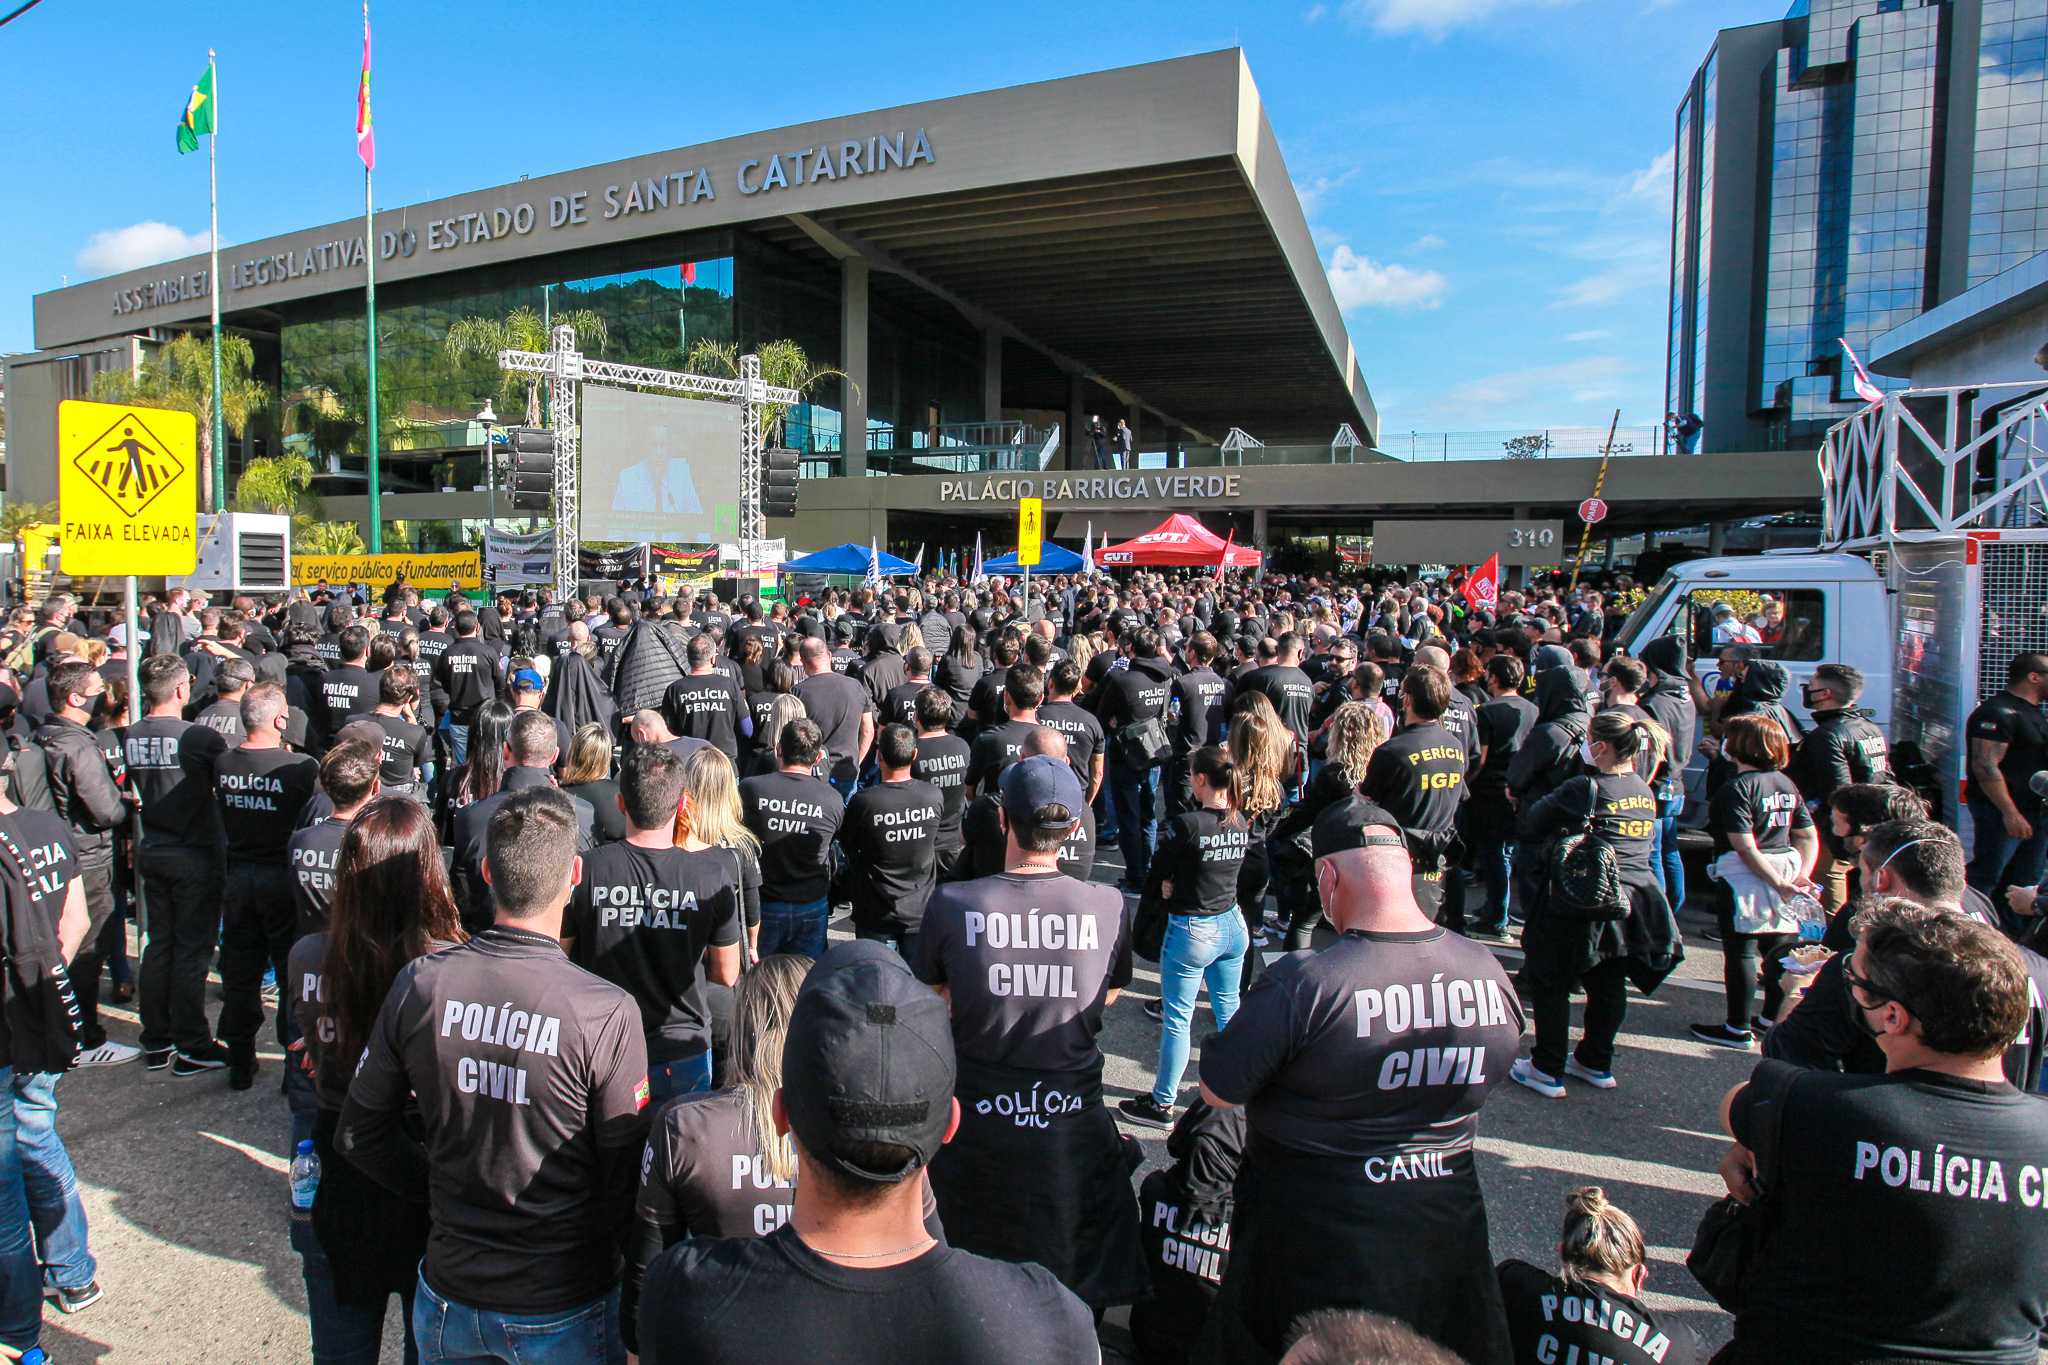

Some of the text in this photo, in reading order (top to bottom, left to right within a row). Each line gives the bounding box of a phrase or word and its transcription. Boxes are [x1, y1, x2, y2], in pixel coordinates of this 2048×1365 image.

[231, 237, 367, 290] LEGISLATIVA
[381, 228, 417, 260] DO
[428, 202, 535, 252] ESTADO
[550, 190, 588, 228] DE
[604, 170, 716, 219] SANTA
[737, 128, 936, 196] CATARINA
[940, 474, 1241, 501] PALÁCIO BARRIGA VERDE
[1587, 501, 1599, 521] PARE
[66, 523, 191, 542] FAIXA ELEVADA
[1138, 533, 1185, 542] CUT
[1508, 528, 1554, 549] 310
[1103, 552, 1127, 562] CUT
[306, 564, 348, 582] serviço
[351, 561, 392, 583] público
[403, 560, 478, 581] fundamental.
[419, 639, 448, 650] OLÍCI
[602, 637, 620, 645] POLÍ
[320, 651, 340, 660] ENAL
[420, 647, 442, 656] ENA
[448, 654, 478, 666] POLÍCIA
[453, 663, 473, 673] CIVIL
[711, 665, 730, 678] OLÍCIA
[323, 682, 359, 698] POLÍCIA
[680, 688, 730, 703] POLÍCIA
[1139, 687, 1166, 699] POLÍCI
[1283, 683, 1311, 693] PERÍCIA
[327, 696, 351, 709] CIVIL
[686, 701, 726, 714] PENAL
[195, 713, 237, 734] OLÍCIA
[1441, 708, 1469, 722] LÍCIA
[919, 753, 966, 773] POLÍCIA
[1408, 745, 1465, 766] PERÍCIA
[220, 772, 283, 793] POLÍCIA
[930, 773, 962, 789] CIVIL
[1421, 772, 1461, 789] IGP
[226, 793, 277, 811] PENAL
[758, 797, 823, 819] POLÍCIA
[1607, 794, 1657, 815] PERÍCIA
[767, 817, 809, 835] CIVIL
[873, 806, 936, 826] POLÍCIA
[885, 826, 927, 843] CIVIL
[1619, 820, 1655, 837] IGP
[292, 847, 338, 869] POLÍ
[298, 870, 338, 889] PEN
[1423, 871, 1443, 882] IGP
[593, 883, 699, 911] POLÍCIA
[601, 907, 688, 930] PENAL
[965, 908, 1099, 950] POLÍCIA
[988, 963, 1078, 998] CIVIL
[1354, 972, 1508, 1038] POLÍCIA
[441, 1001, 561, 1057] POLÍCIA
[1377, 1046, 1486, 1091] CIVIL
[456, 1056, 530, 1105] CIVIL
[976, 1081, 1082, 1116] POLÍCIA
[1364, 1152, 1453, 1183] CANIL
[1854, 1143, 2008, 1202] POLÍCIA
[1162, 1237, 1222, 1282] CIVIL
[1536, 1333, 1628, 1365] CIV
